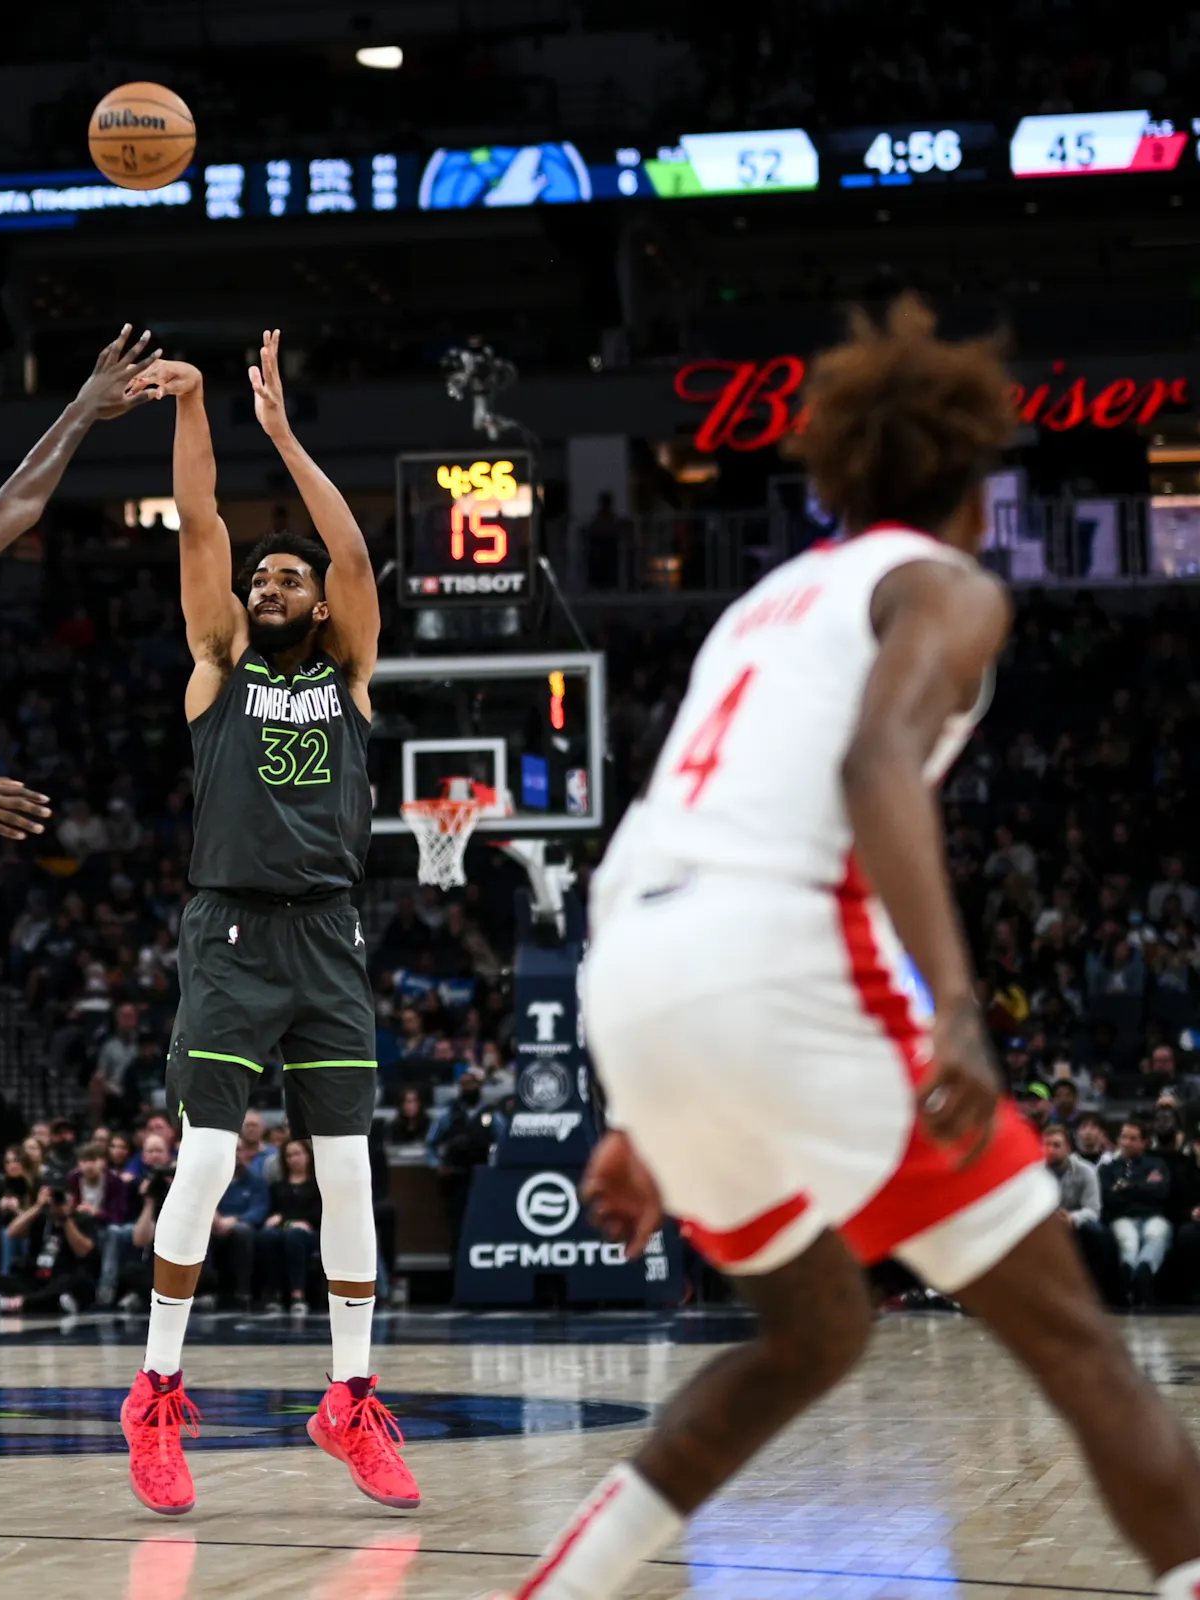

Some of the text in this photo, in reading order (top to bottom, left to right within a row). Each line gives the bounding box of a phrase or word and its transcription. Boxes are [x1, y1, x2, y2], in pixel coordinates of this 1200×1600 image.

[98, 108, 166, 131] Wilson
[737, 148, 783, 184] 52
[863, 129, 963, 175] 4:56
[1046, 132, 1096, 167] 45
[674, 354, 1188, 452] Biser
[436, 461, 517, 500] 4:56
[451, 500, 507, 564] 15
[440, 572, 524, 594] TISSOT
[258, 727, 331, 785] 32
[673, 662, 756, 812] 4
[469, 1241, 629, 1269] CFMOTO
